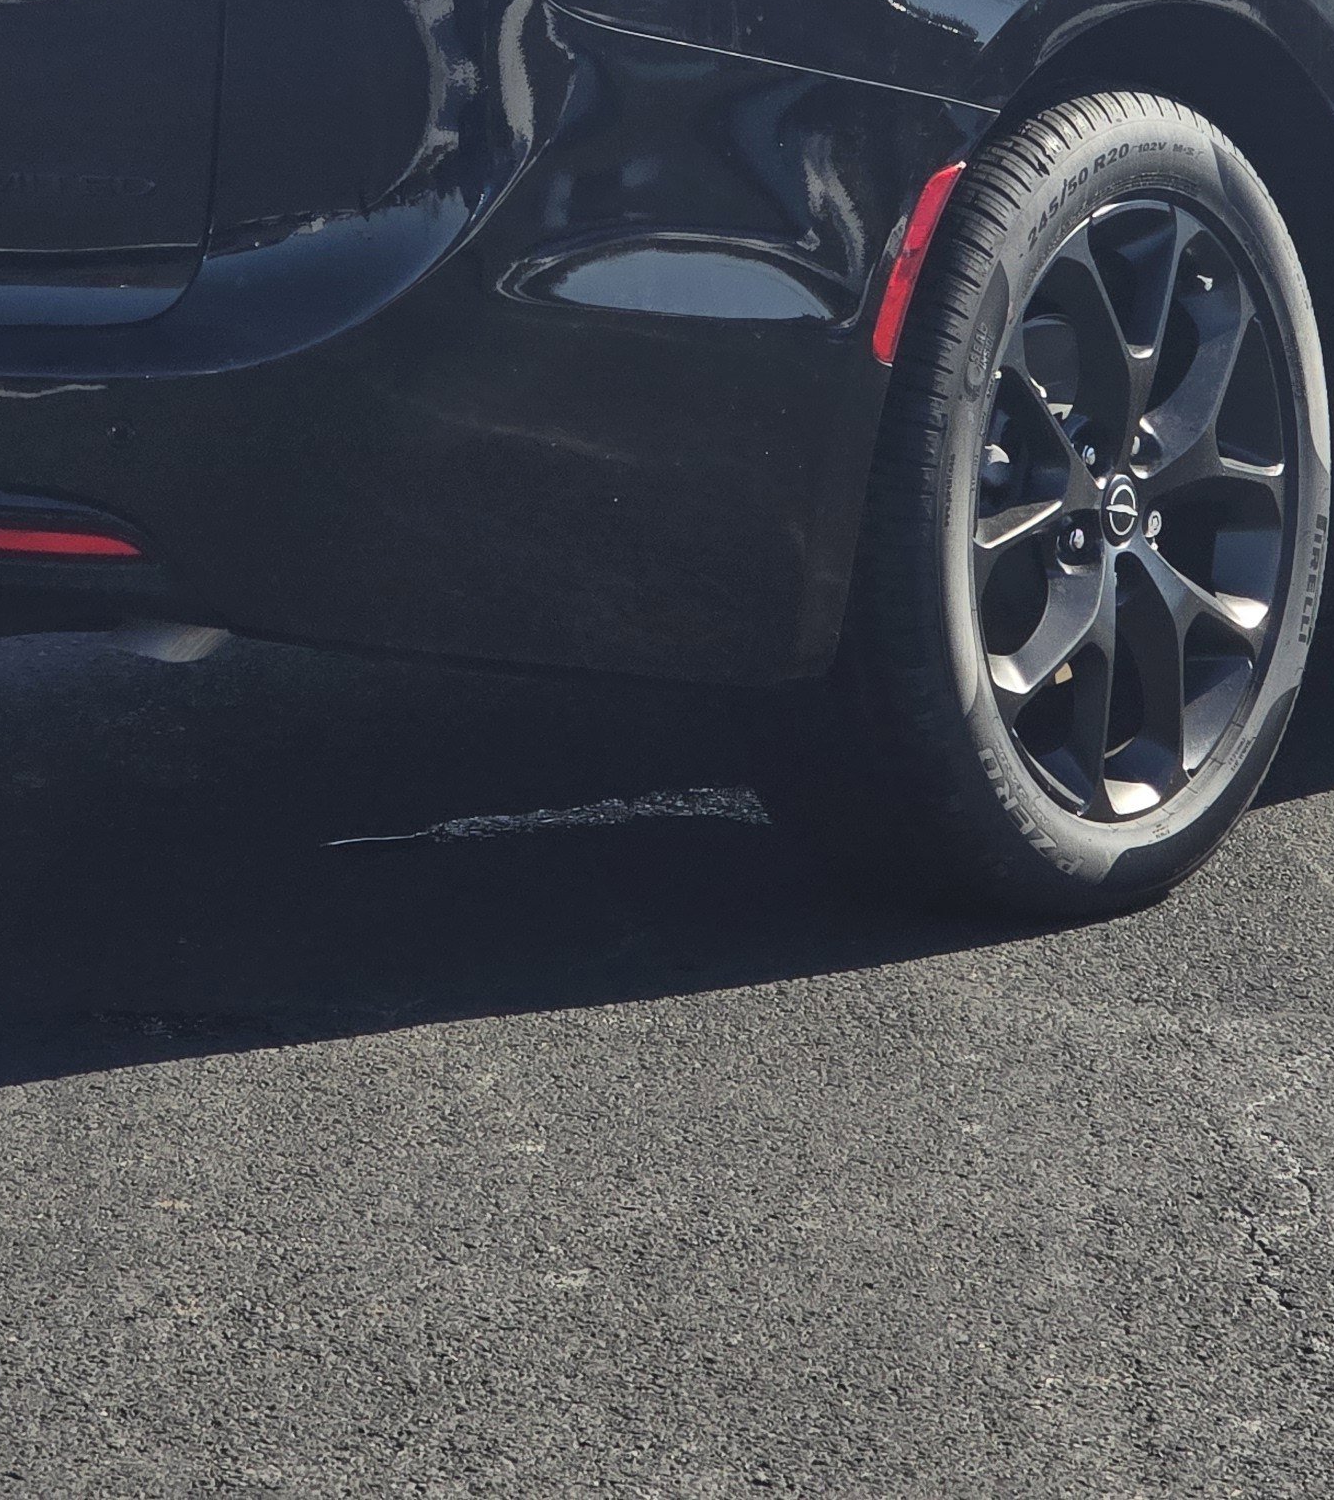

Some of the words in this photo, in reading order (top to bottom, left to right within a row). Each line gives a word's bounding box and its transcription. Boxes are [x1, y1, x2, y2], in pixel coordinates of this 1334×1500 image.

[1026, 170, 1089, 252] 245/50
[1092, 143, 1130, 174] R20
[1298, 514, 1328, 643] PIRELLI
[977, 747, 1057, 856] ZERO
